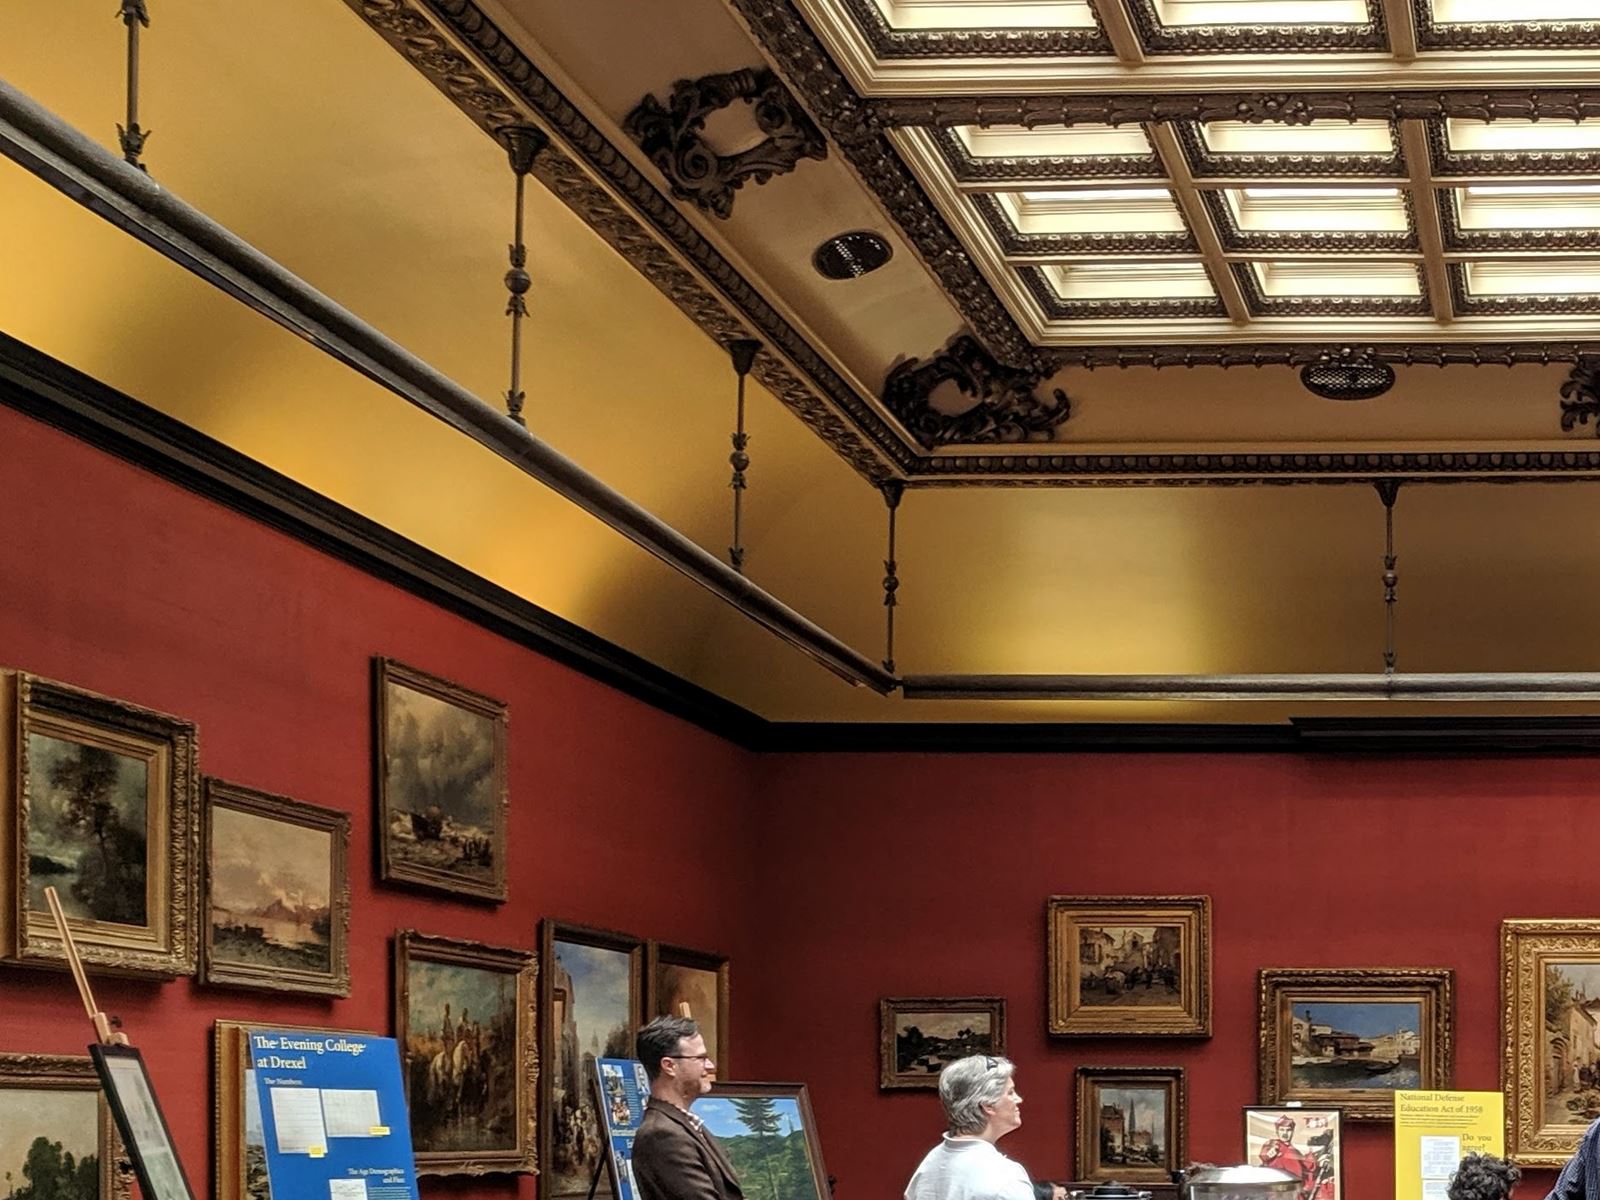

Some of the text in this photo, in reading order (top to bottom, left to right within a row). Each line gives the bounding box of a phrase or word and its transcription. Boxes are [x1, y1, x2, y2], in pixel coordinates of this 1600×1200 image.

[253, 1036, 366, 1056] The Evening College
[257, 1056, 307, 1069] at Drexel
[1400, 1093, 1465, 1102] National Defense
[1400, 1105, 1439, 1113] Education
[1441, 1105, 1454, 1113] Act
[1455, 1105, 1464, 1113] of
[1477, 1135, 1492, 1143] you
